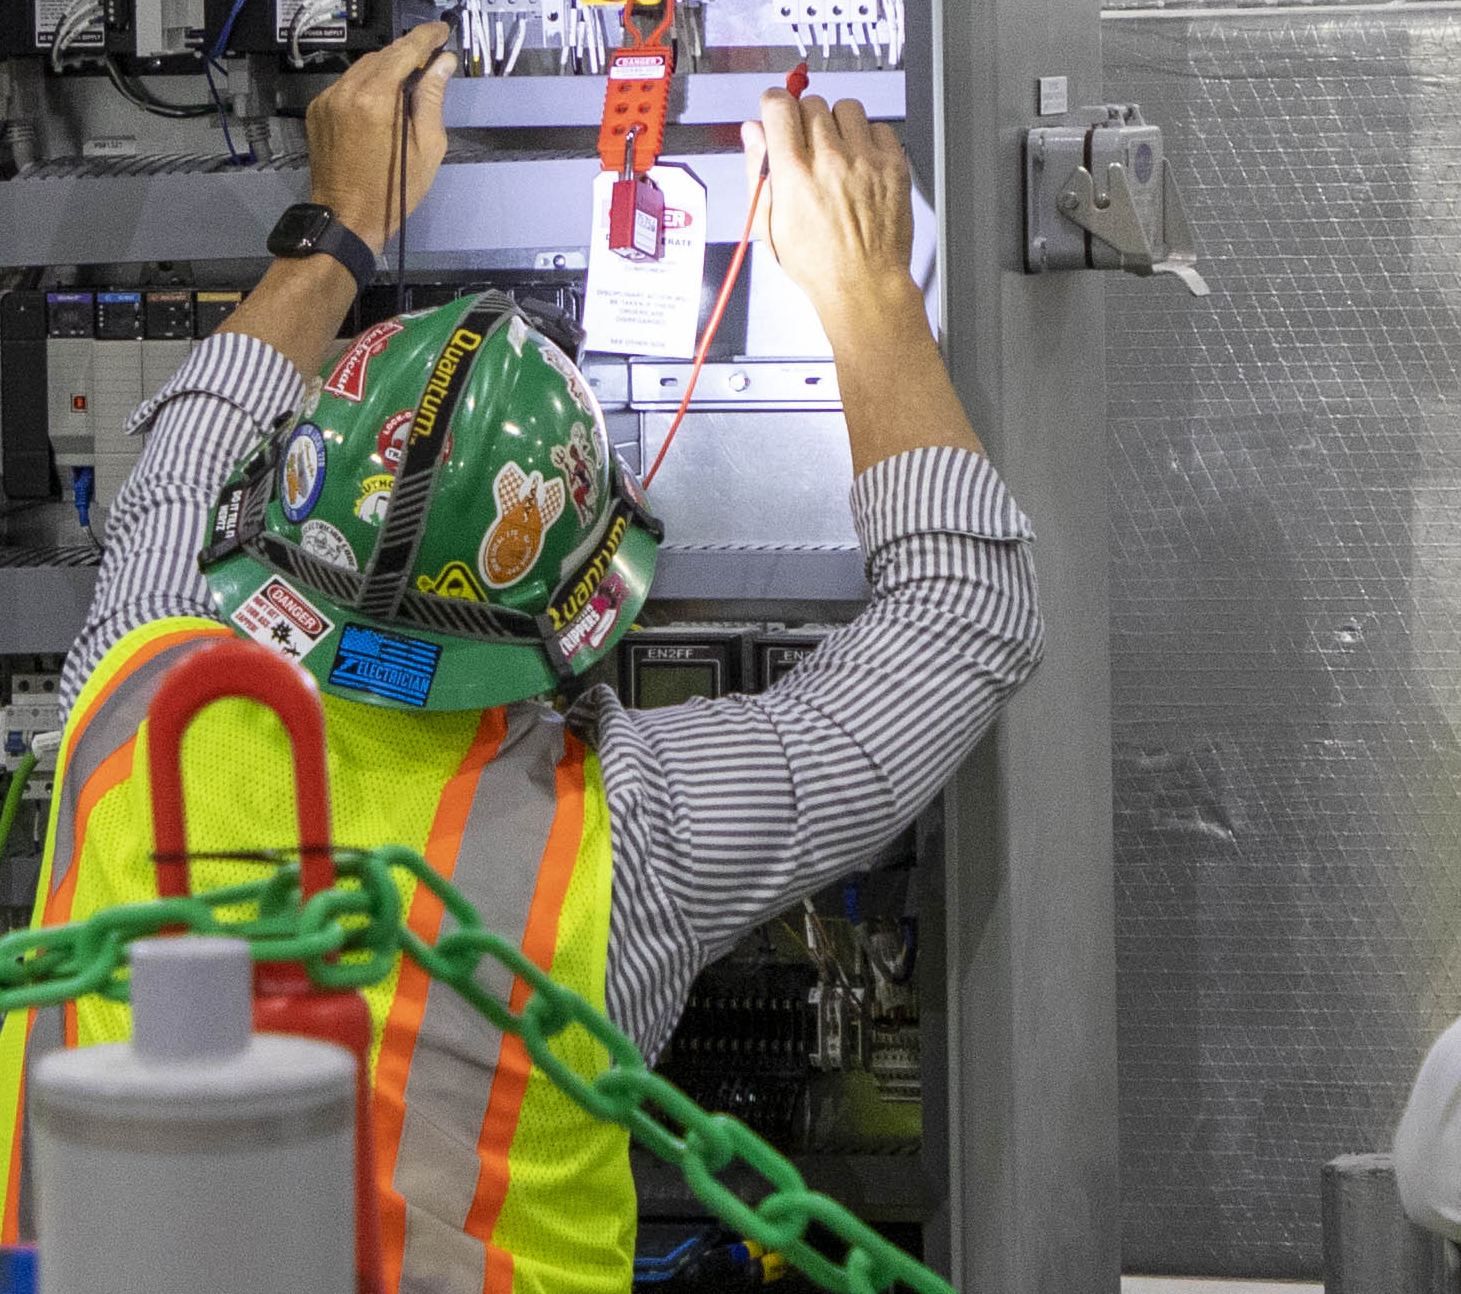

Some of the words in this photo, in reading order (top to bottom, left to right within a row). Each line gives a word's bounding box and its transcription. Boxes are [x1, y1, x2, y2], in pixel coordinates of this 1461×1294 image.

[411, 327, 483, 440] Quantum
[272, 589, 318, 630] DANGER
[356, 659, 432, 694] ELECTRICIAN
